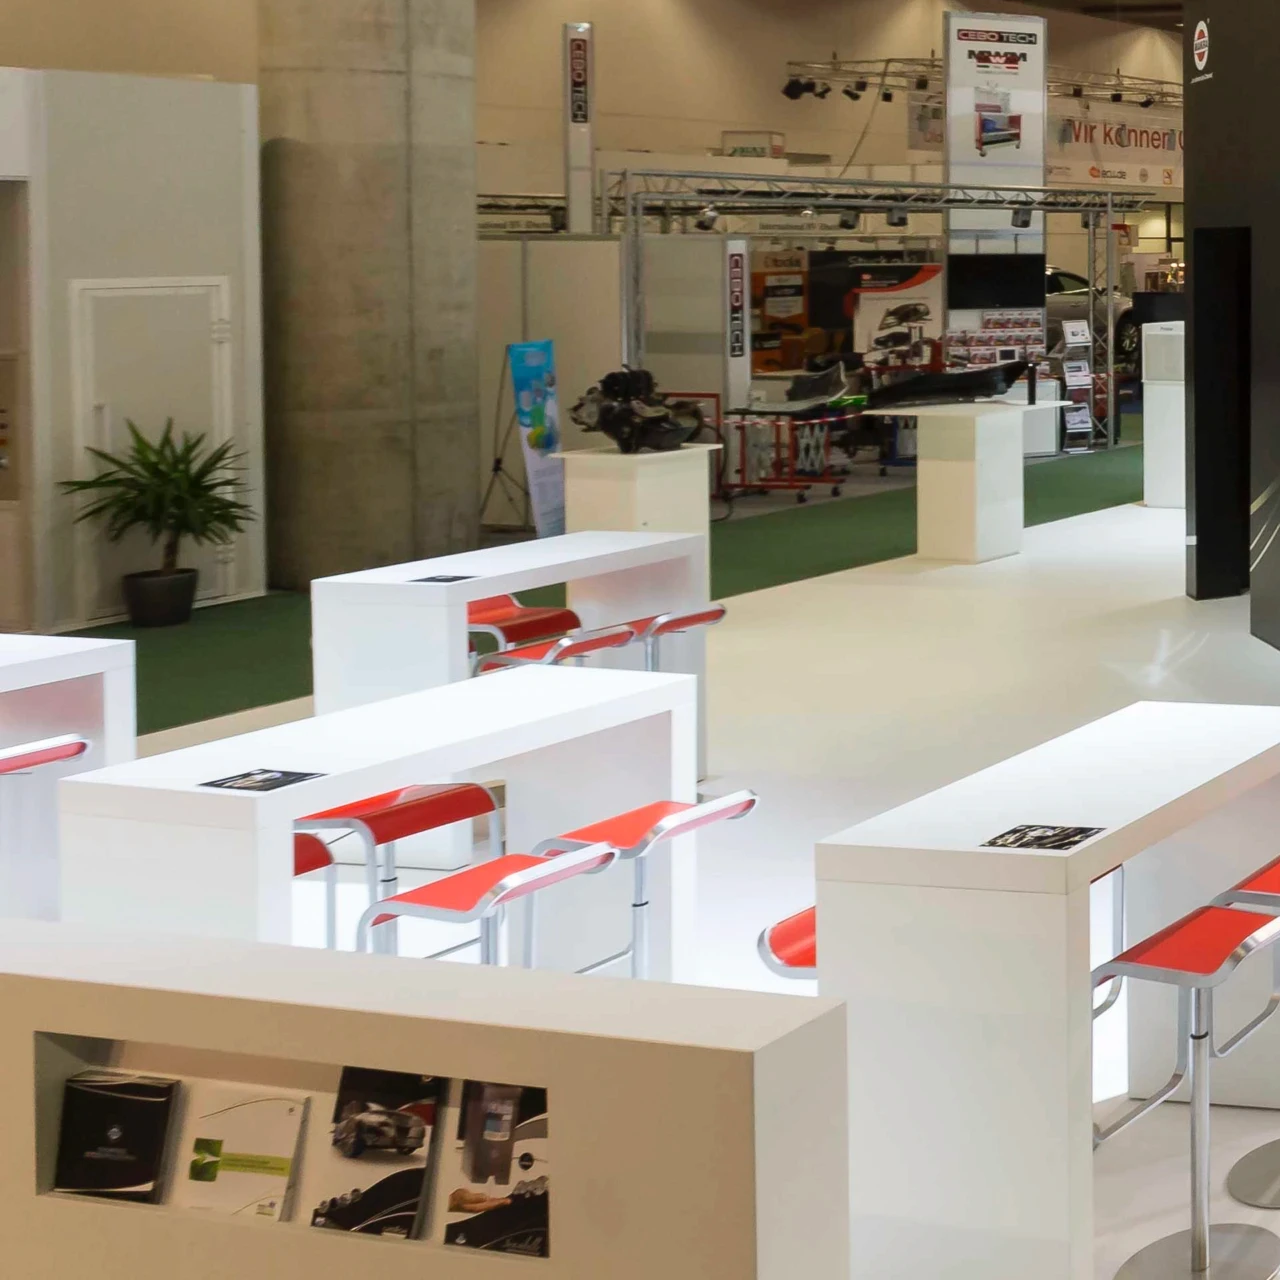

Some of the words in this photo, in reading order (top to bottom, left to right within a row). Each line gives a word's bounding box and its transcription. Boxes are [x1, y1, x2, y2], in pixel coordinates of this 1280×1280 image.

[958, 30, 1000, 41] CEBO
[1001, 33, 1035, 43] TECH
[572, 41, 585, 82] CEBO
[572, 87, 586, 121] TECH
[730, 256, 743, 306] CEBO
[731, 310, 744, 356] TECH
